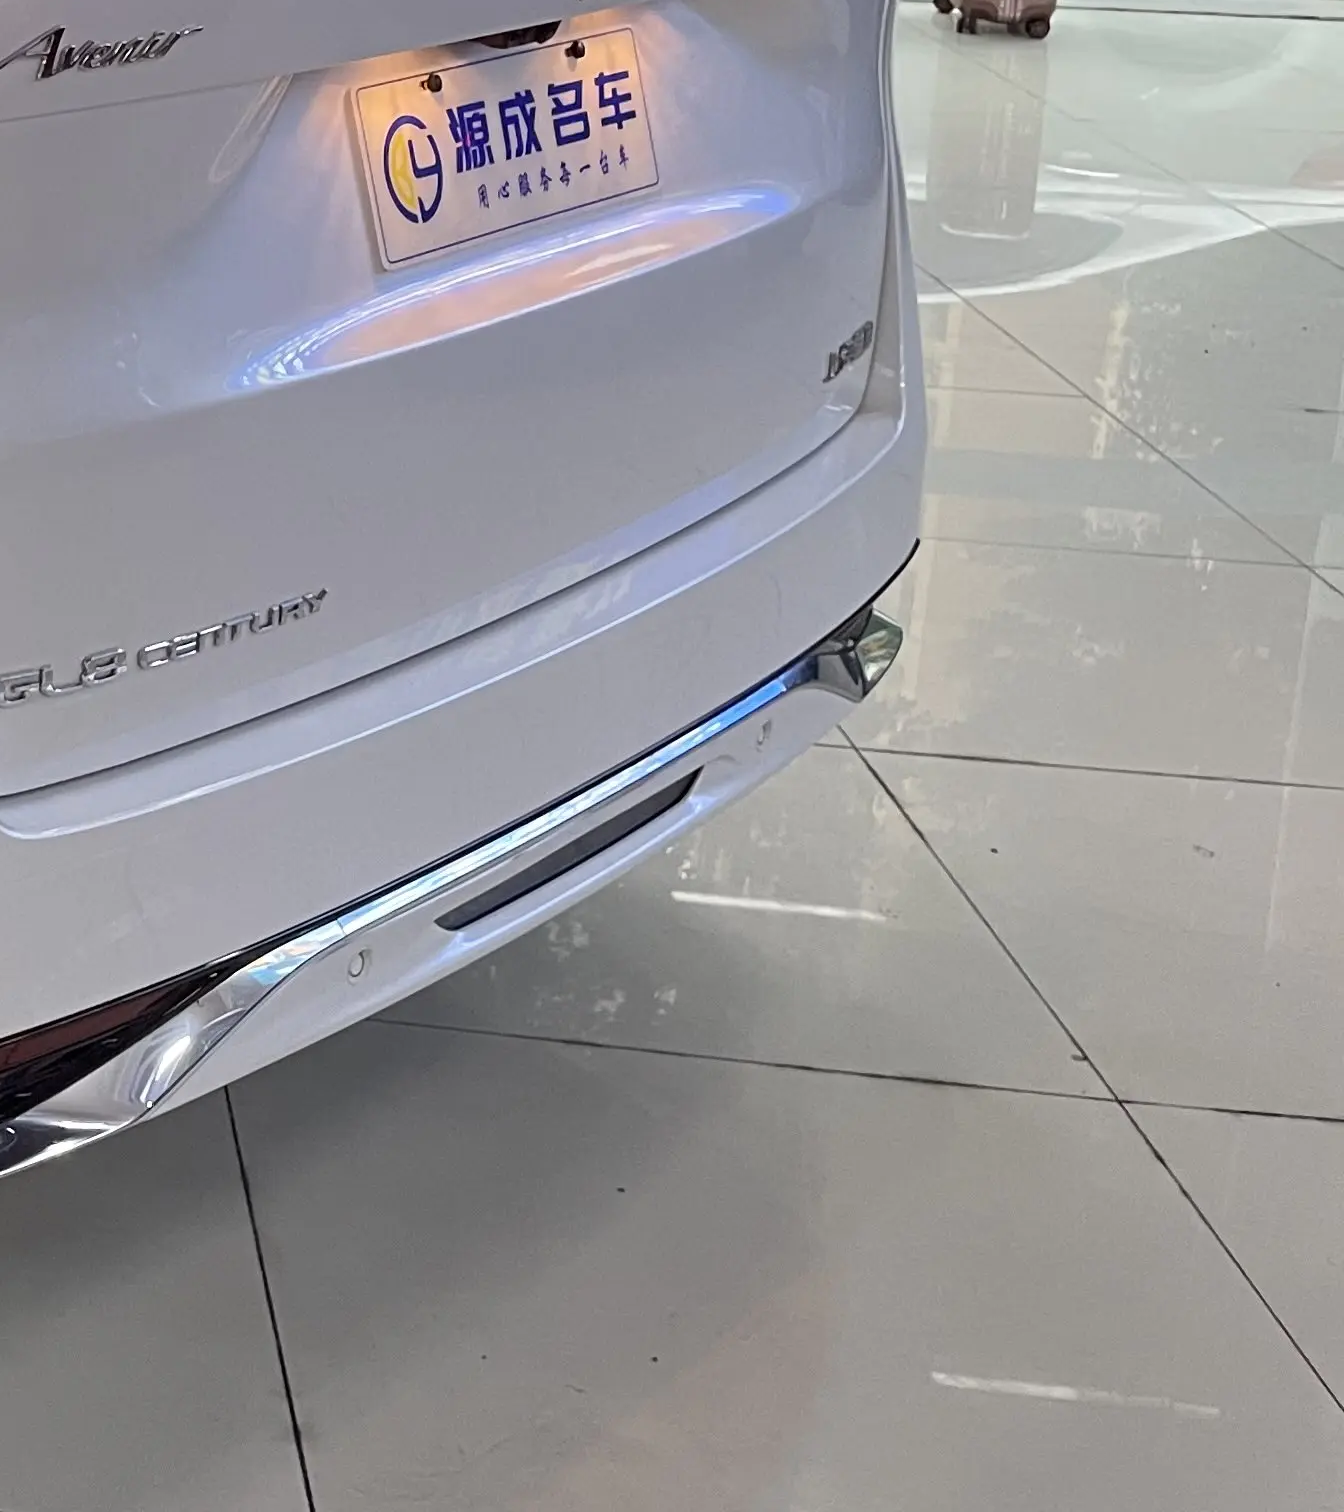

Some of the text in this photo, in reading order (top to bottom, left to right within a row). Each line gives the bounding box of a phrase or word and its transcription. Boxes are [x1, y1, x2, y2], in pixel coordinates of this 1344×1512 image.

[445, 70, 638, 174] 源成名车
[476, 143, 631, 209] 用心服务每一台车
[136, 586, 330, 671] CENTURY
